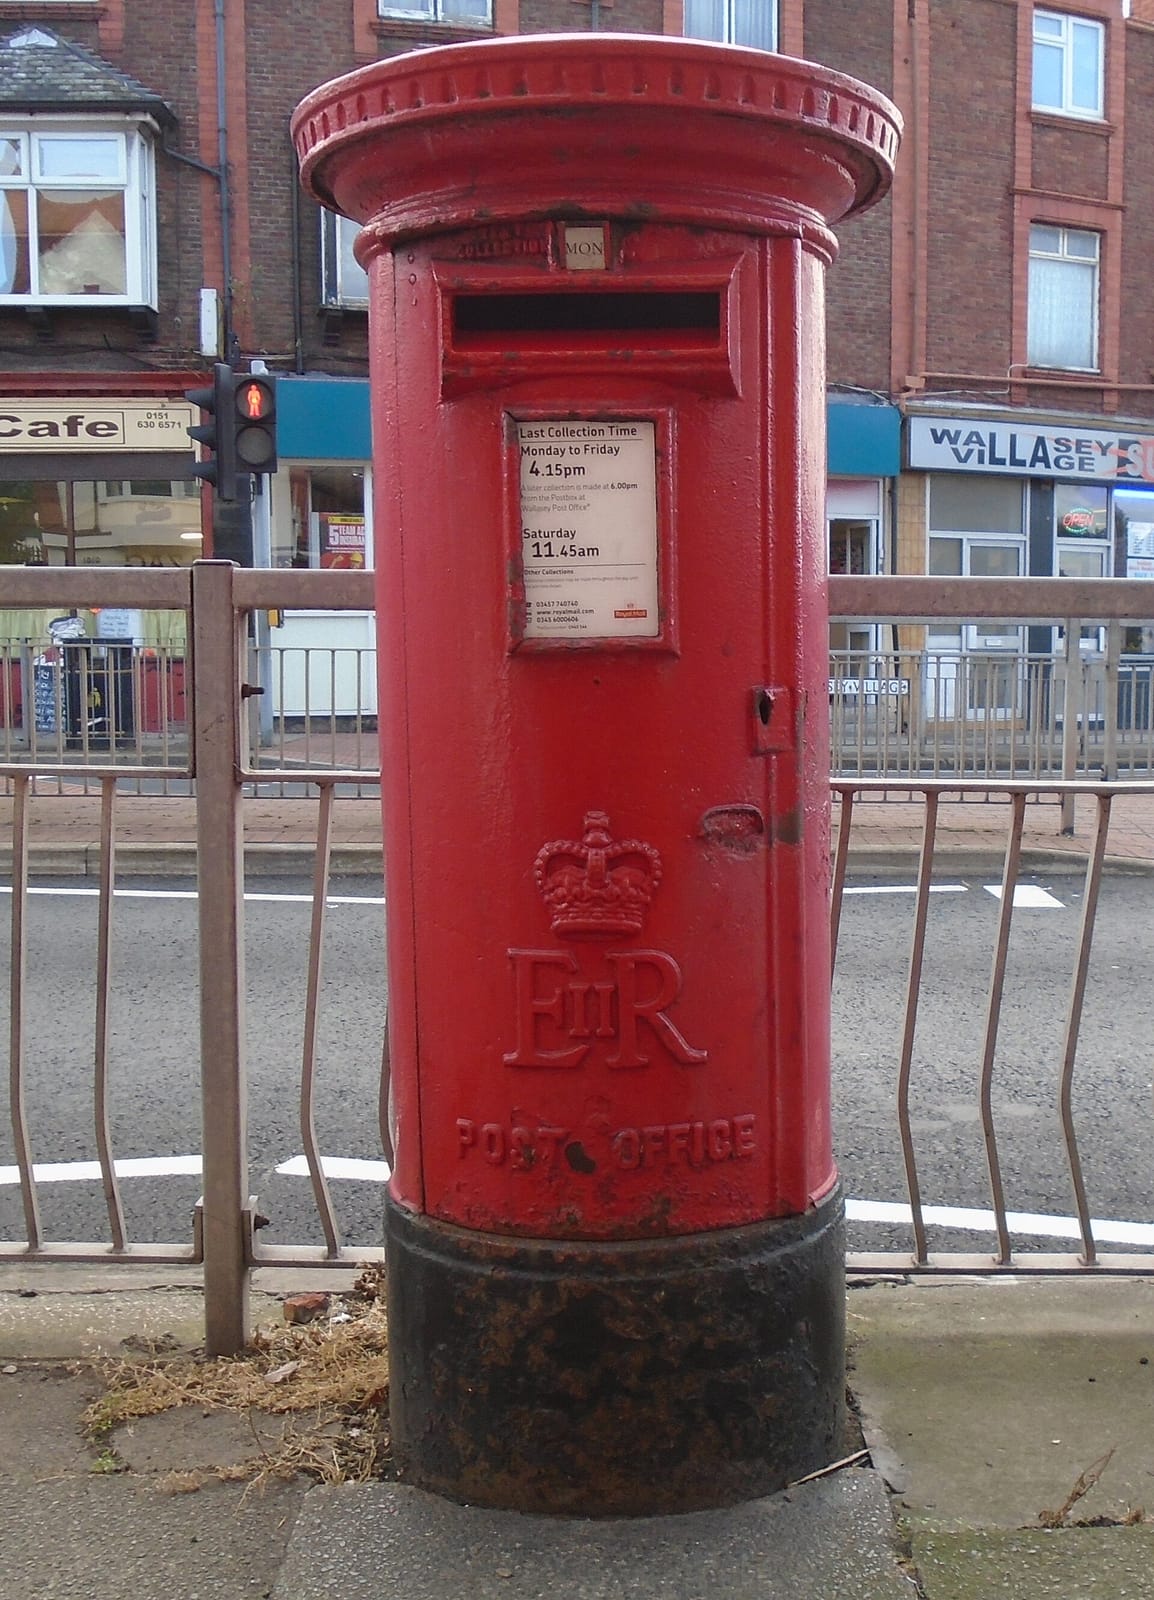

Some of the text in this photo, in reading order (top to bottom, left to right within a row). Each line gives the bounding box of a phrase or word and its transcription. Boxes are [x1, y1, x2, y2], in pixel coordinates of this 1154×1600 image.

[566, 242, 603, 255] MON
[146, 412, 169, 420] 0151
[0, 415, 119, 438] Cafe
[137, 421, 182, 429] 630 6571
[520, 425, 637, 439] Last Collection Time
[520, 444, 620, 457] Monday to Friday
[929, 427, 1114, 469] WALLASEY
[950, 432, 1096, 473] VILLAGE
[529, 460, 586, 478] 4.15pm
[610, 482, 638, 490] 6.00pm
[1063, 513, 1095, 527] OPEN
[523, 528, 576, 540] Saturday
[531, 541, 600, 558] 11.45am
[456, 1113, 757, 1171] POST OFFICE
